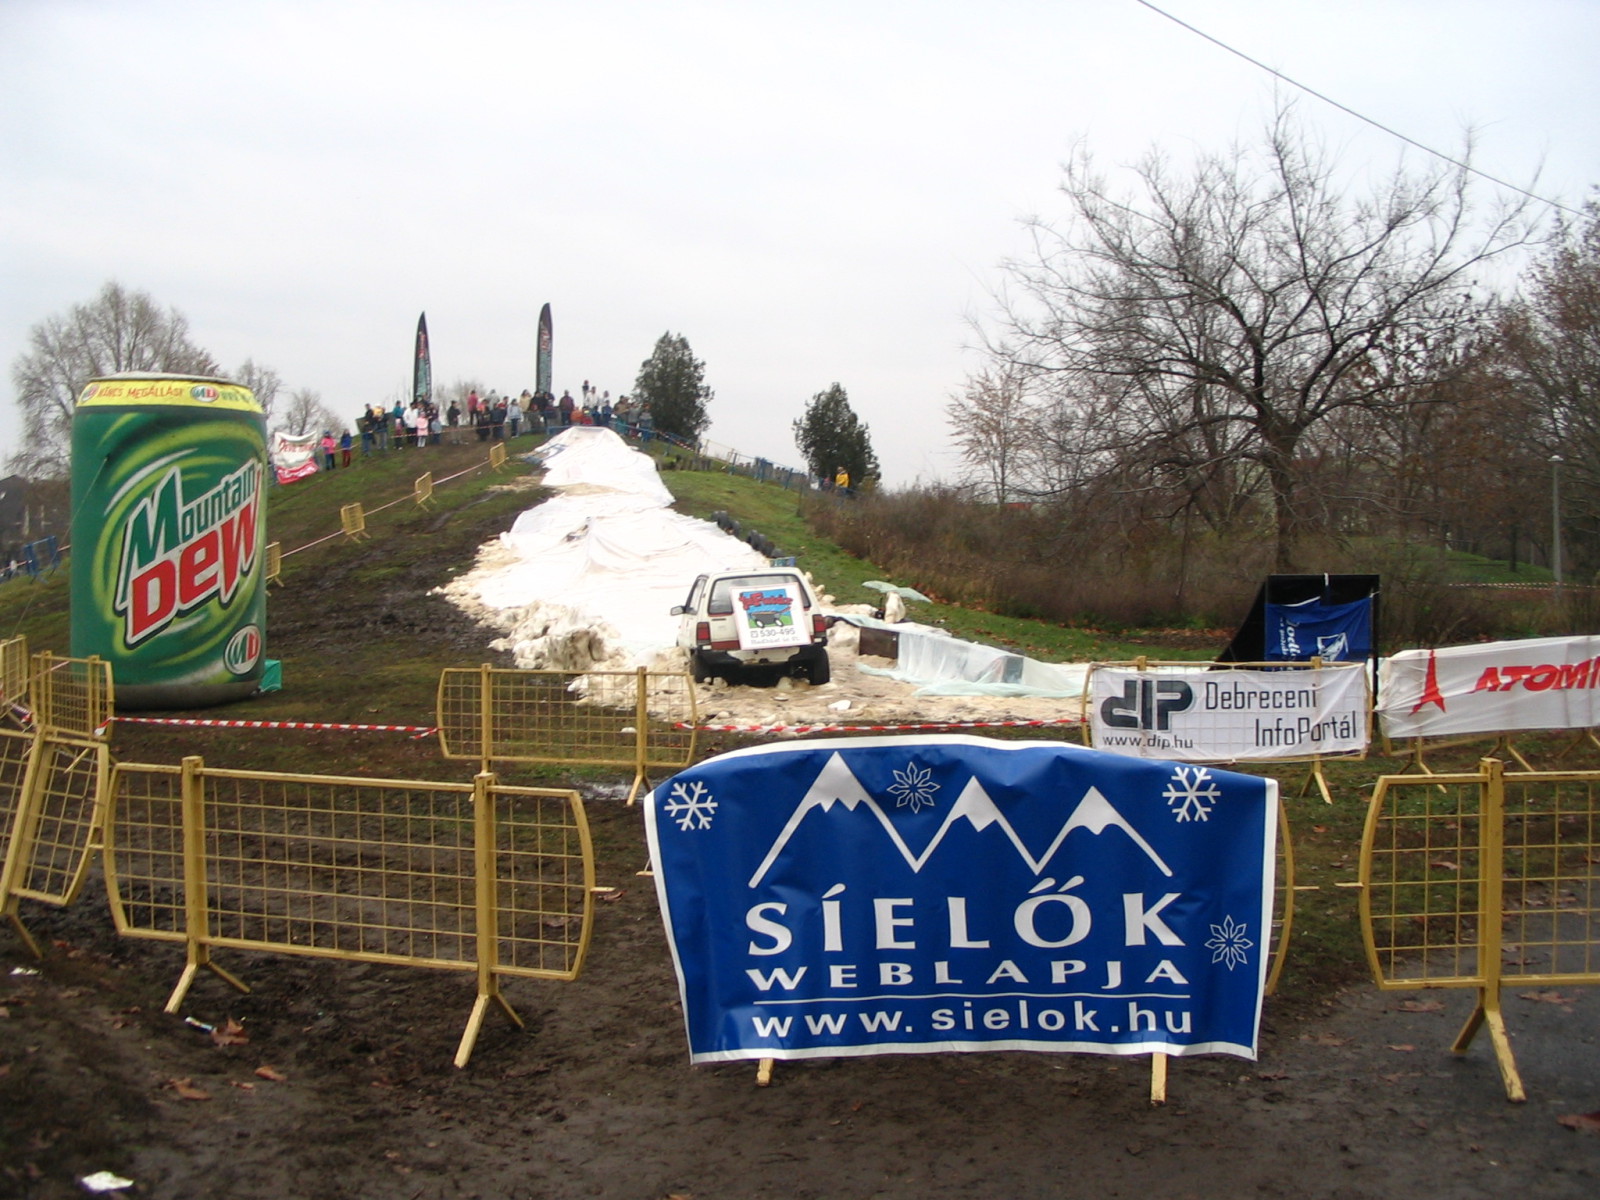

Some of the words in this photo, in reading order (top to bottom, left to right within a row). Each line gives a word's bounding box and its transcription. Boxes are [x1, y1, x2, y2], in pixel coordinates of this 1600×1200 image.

[116, 457, 259, 610] Mountain
[1468, 656, 1600, 693] ATOMI
[1205, 681, 1317, 711] Debreceni
[1102, 733, 1194, 750] www.dip.hu
[1254, 710, 1357, 748] InfoPortál
[745, 874, 1186, 956] SÍELŐK
[745, 959, 1190, 991] WEBLAPJA
